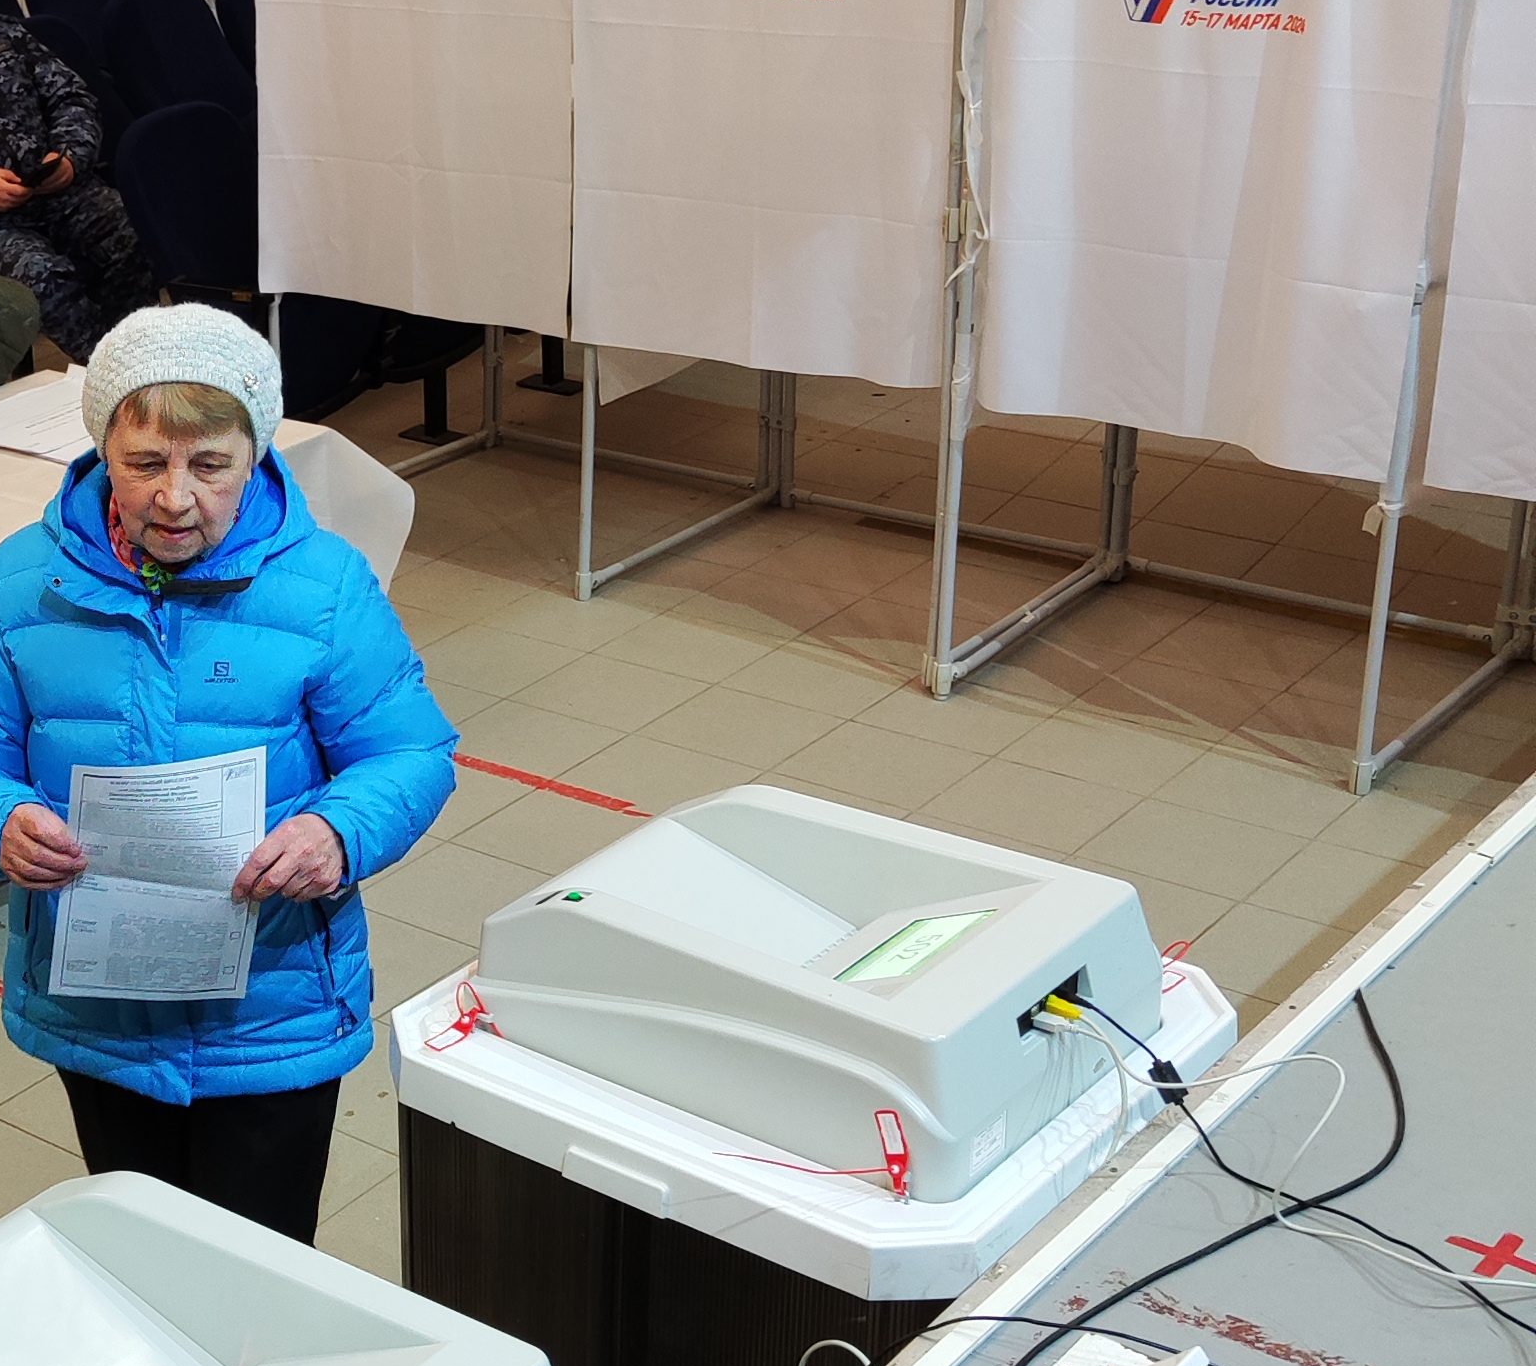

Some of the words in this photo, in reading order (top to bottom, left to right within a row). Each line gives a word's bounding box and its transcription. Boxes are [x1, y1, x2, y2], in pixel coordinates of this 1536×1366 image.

[1224, 13, 1282, 31] МАРТА
[1282, 14, 1306, 35] 2024
[888, 934, 944, 964] 502
